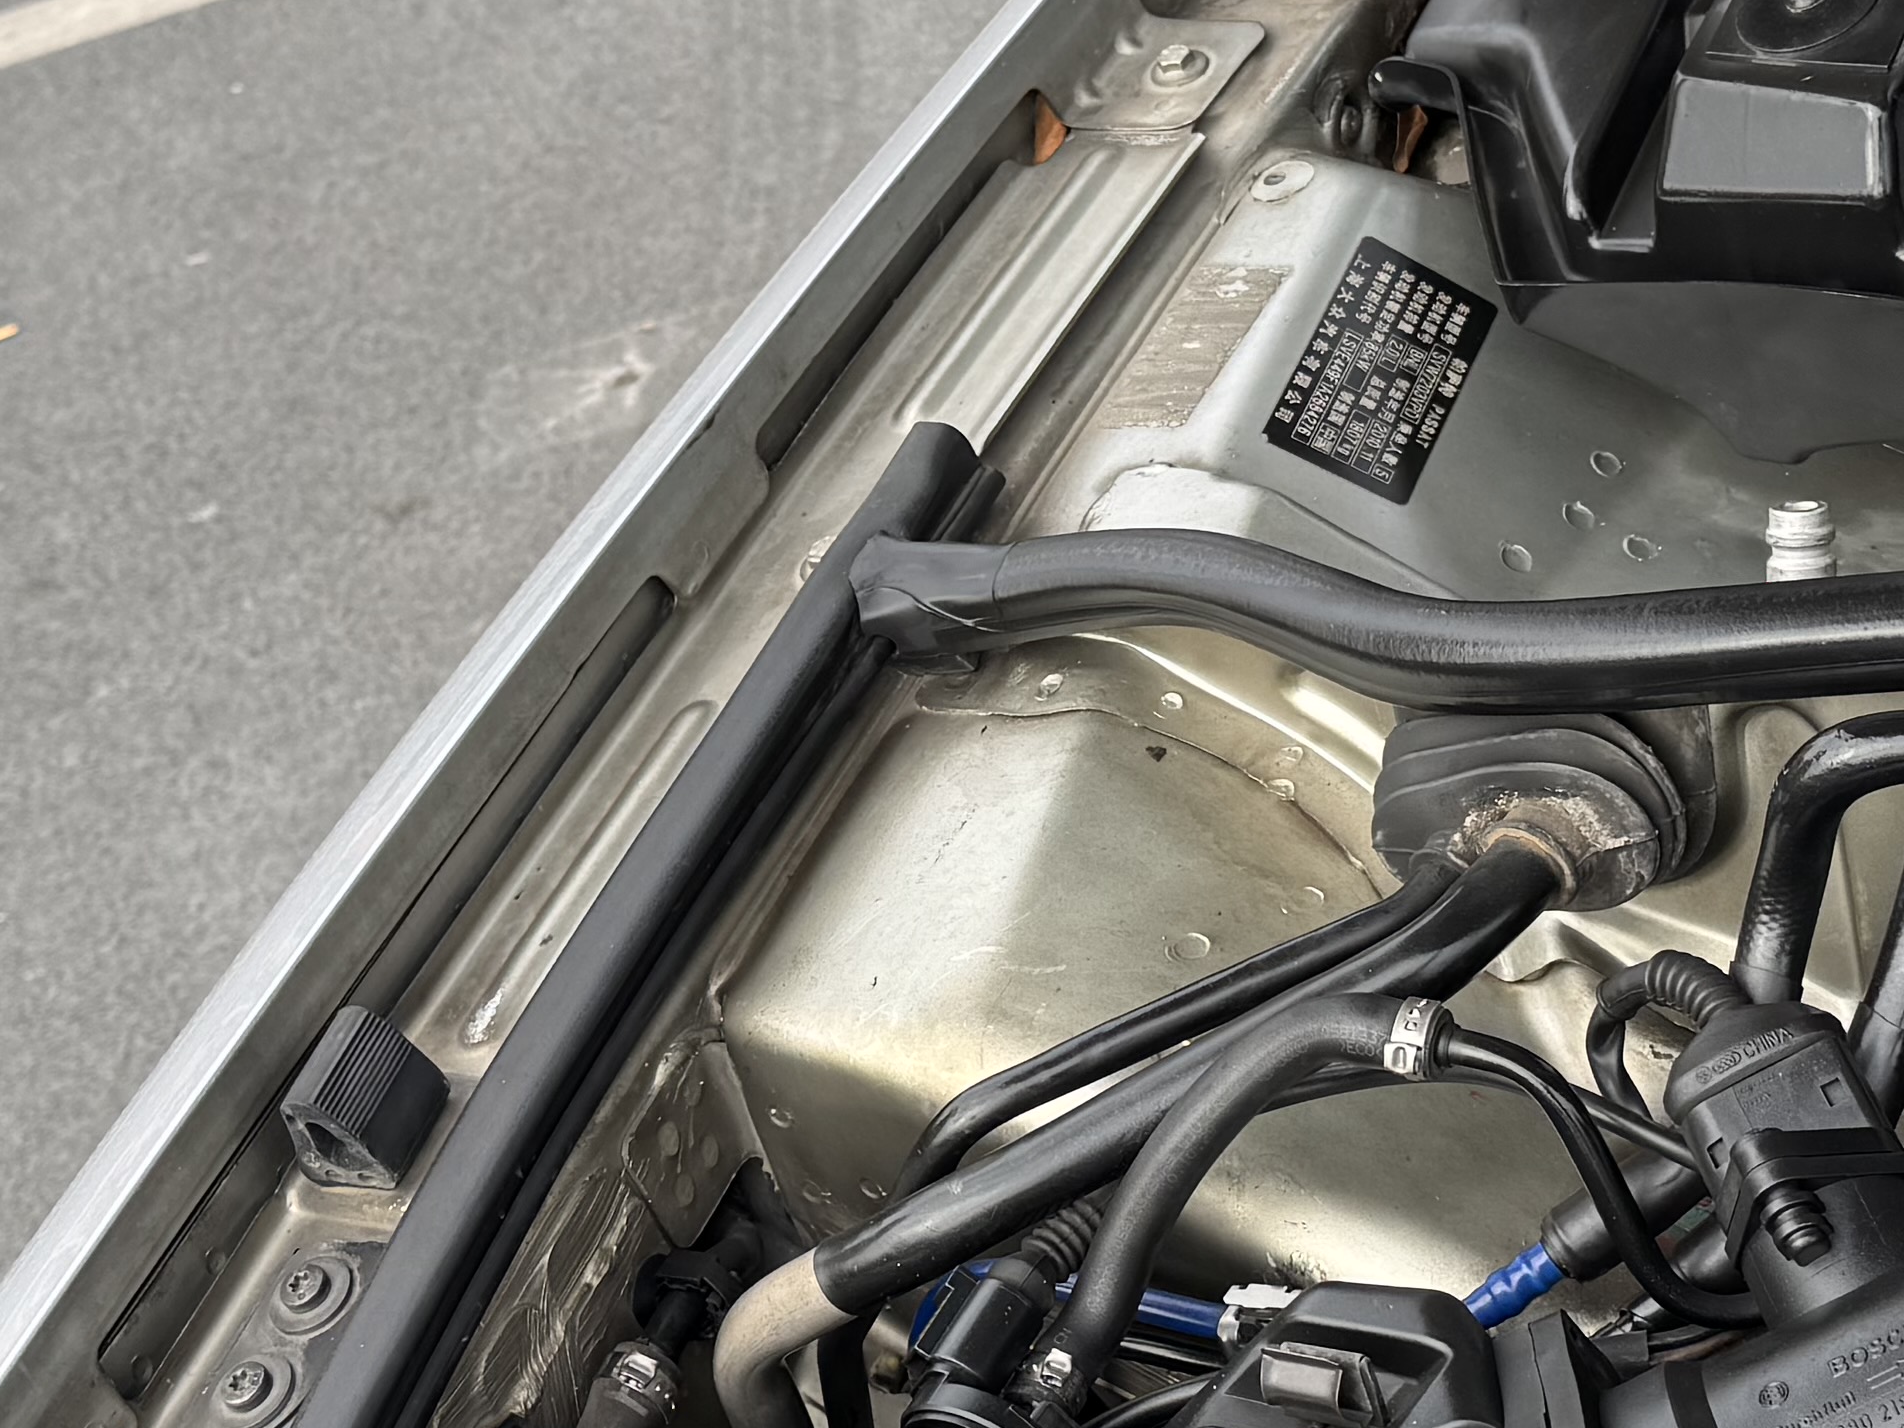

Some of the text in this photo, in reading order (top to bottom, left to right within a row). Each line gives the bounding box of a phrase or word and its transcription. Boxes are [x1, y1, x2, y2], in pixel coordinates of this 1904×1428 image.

[1275, 253, 1371, 424] 上海大众汽车有限公司
[1415, 403, 1445, 449] PASSAT
